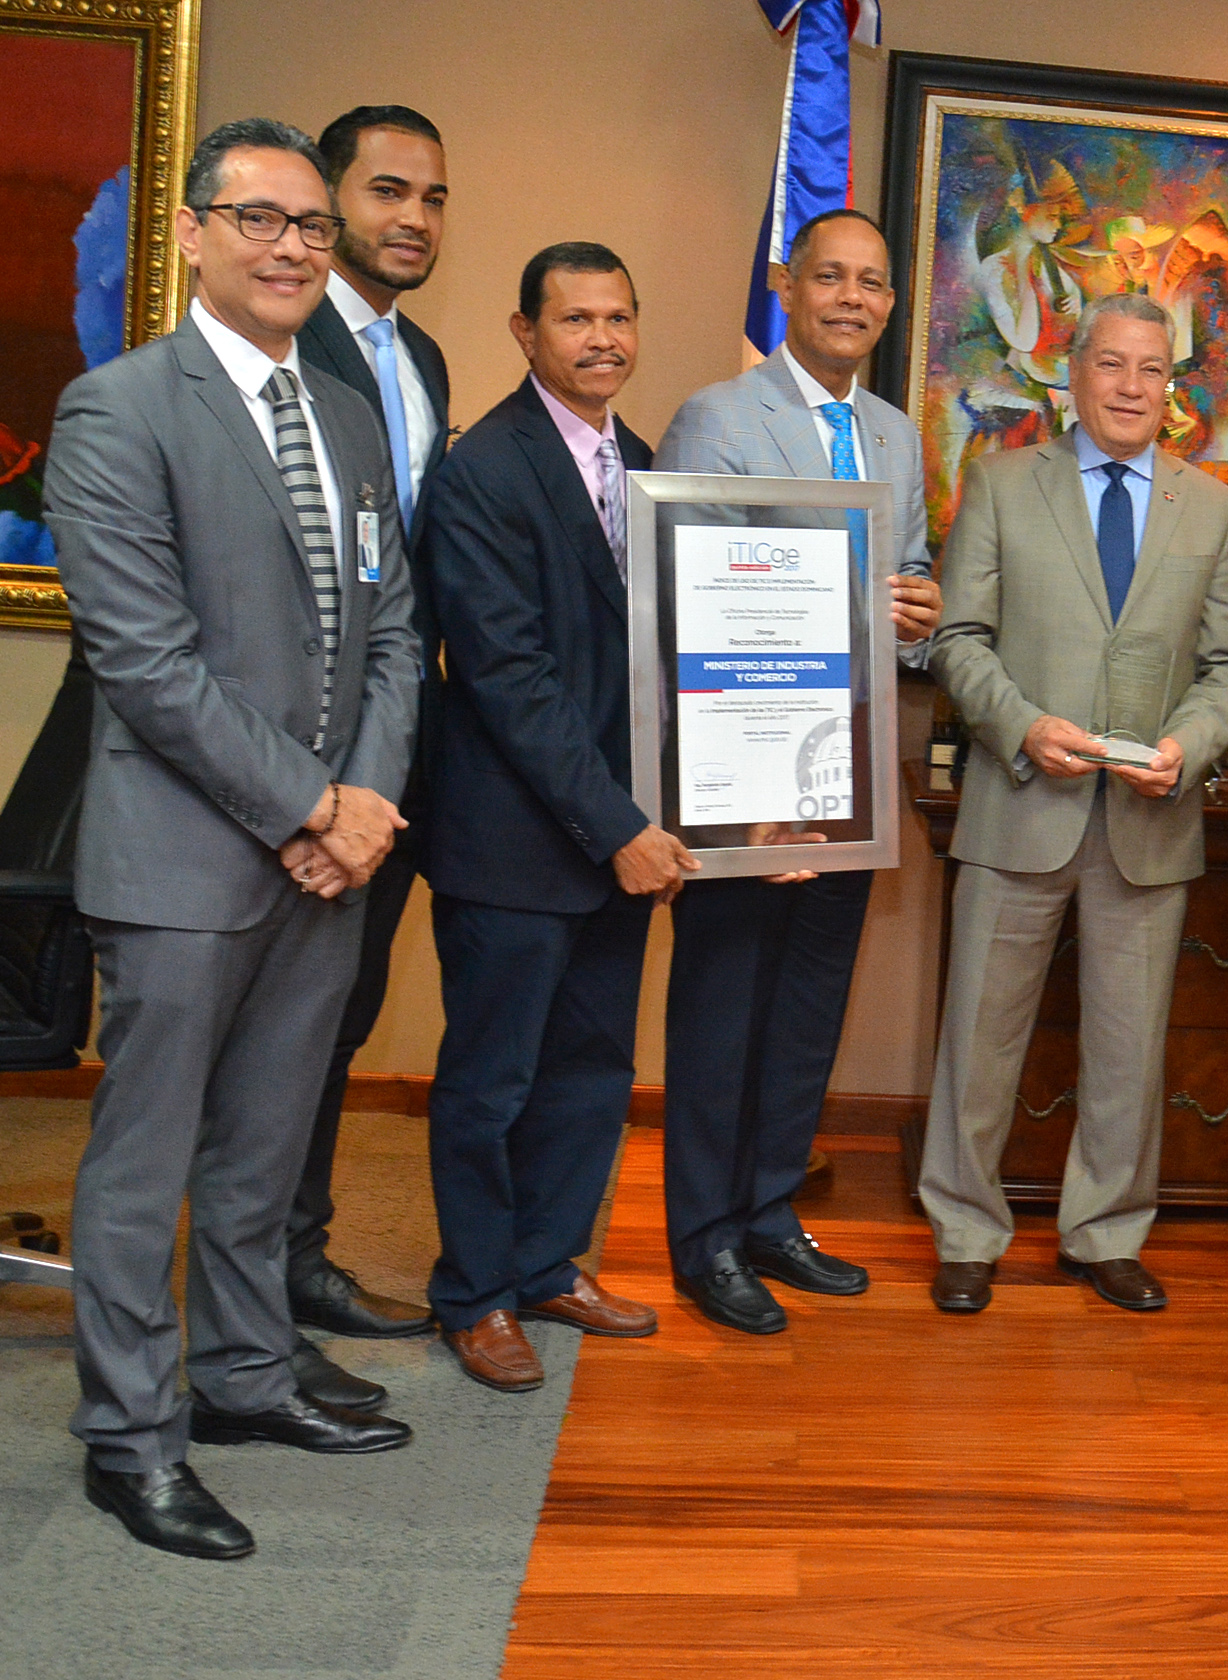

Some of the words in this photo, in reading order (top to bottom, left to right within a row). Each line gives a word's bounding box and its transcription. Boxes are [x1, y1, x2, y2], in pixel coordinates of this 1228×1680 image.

[728, 541, 800, 569] iTICge
[729, 638, 792, 646] Reconocimiento
[703, 660, 760, 671] MINISTERIO
[760, 661, 775, 671] DE
[775, 661, 828, 671] INDUSTRIA
[735, 672, 744, 682] Y
[744, 672, 798, 683] COMERCIO
